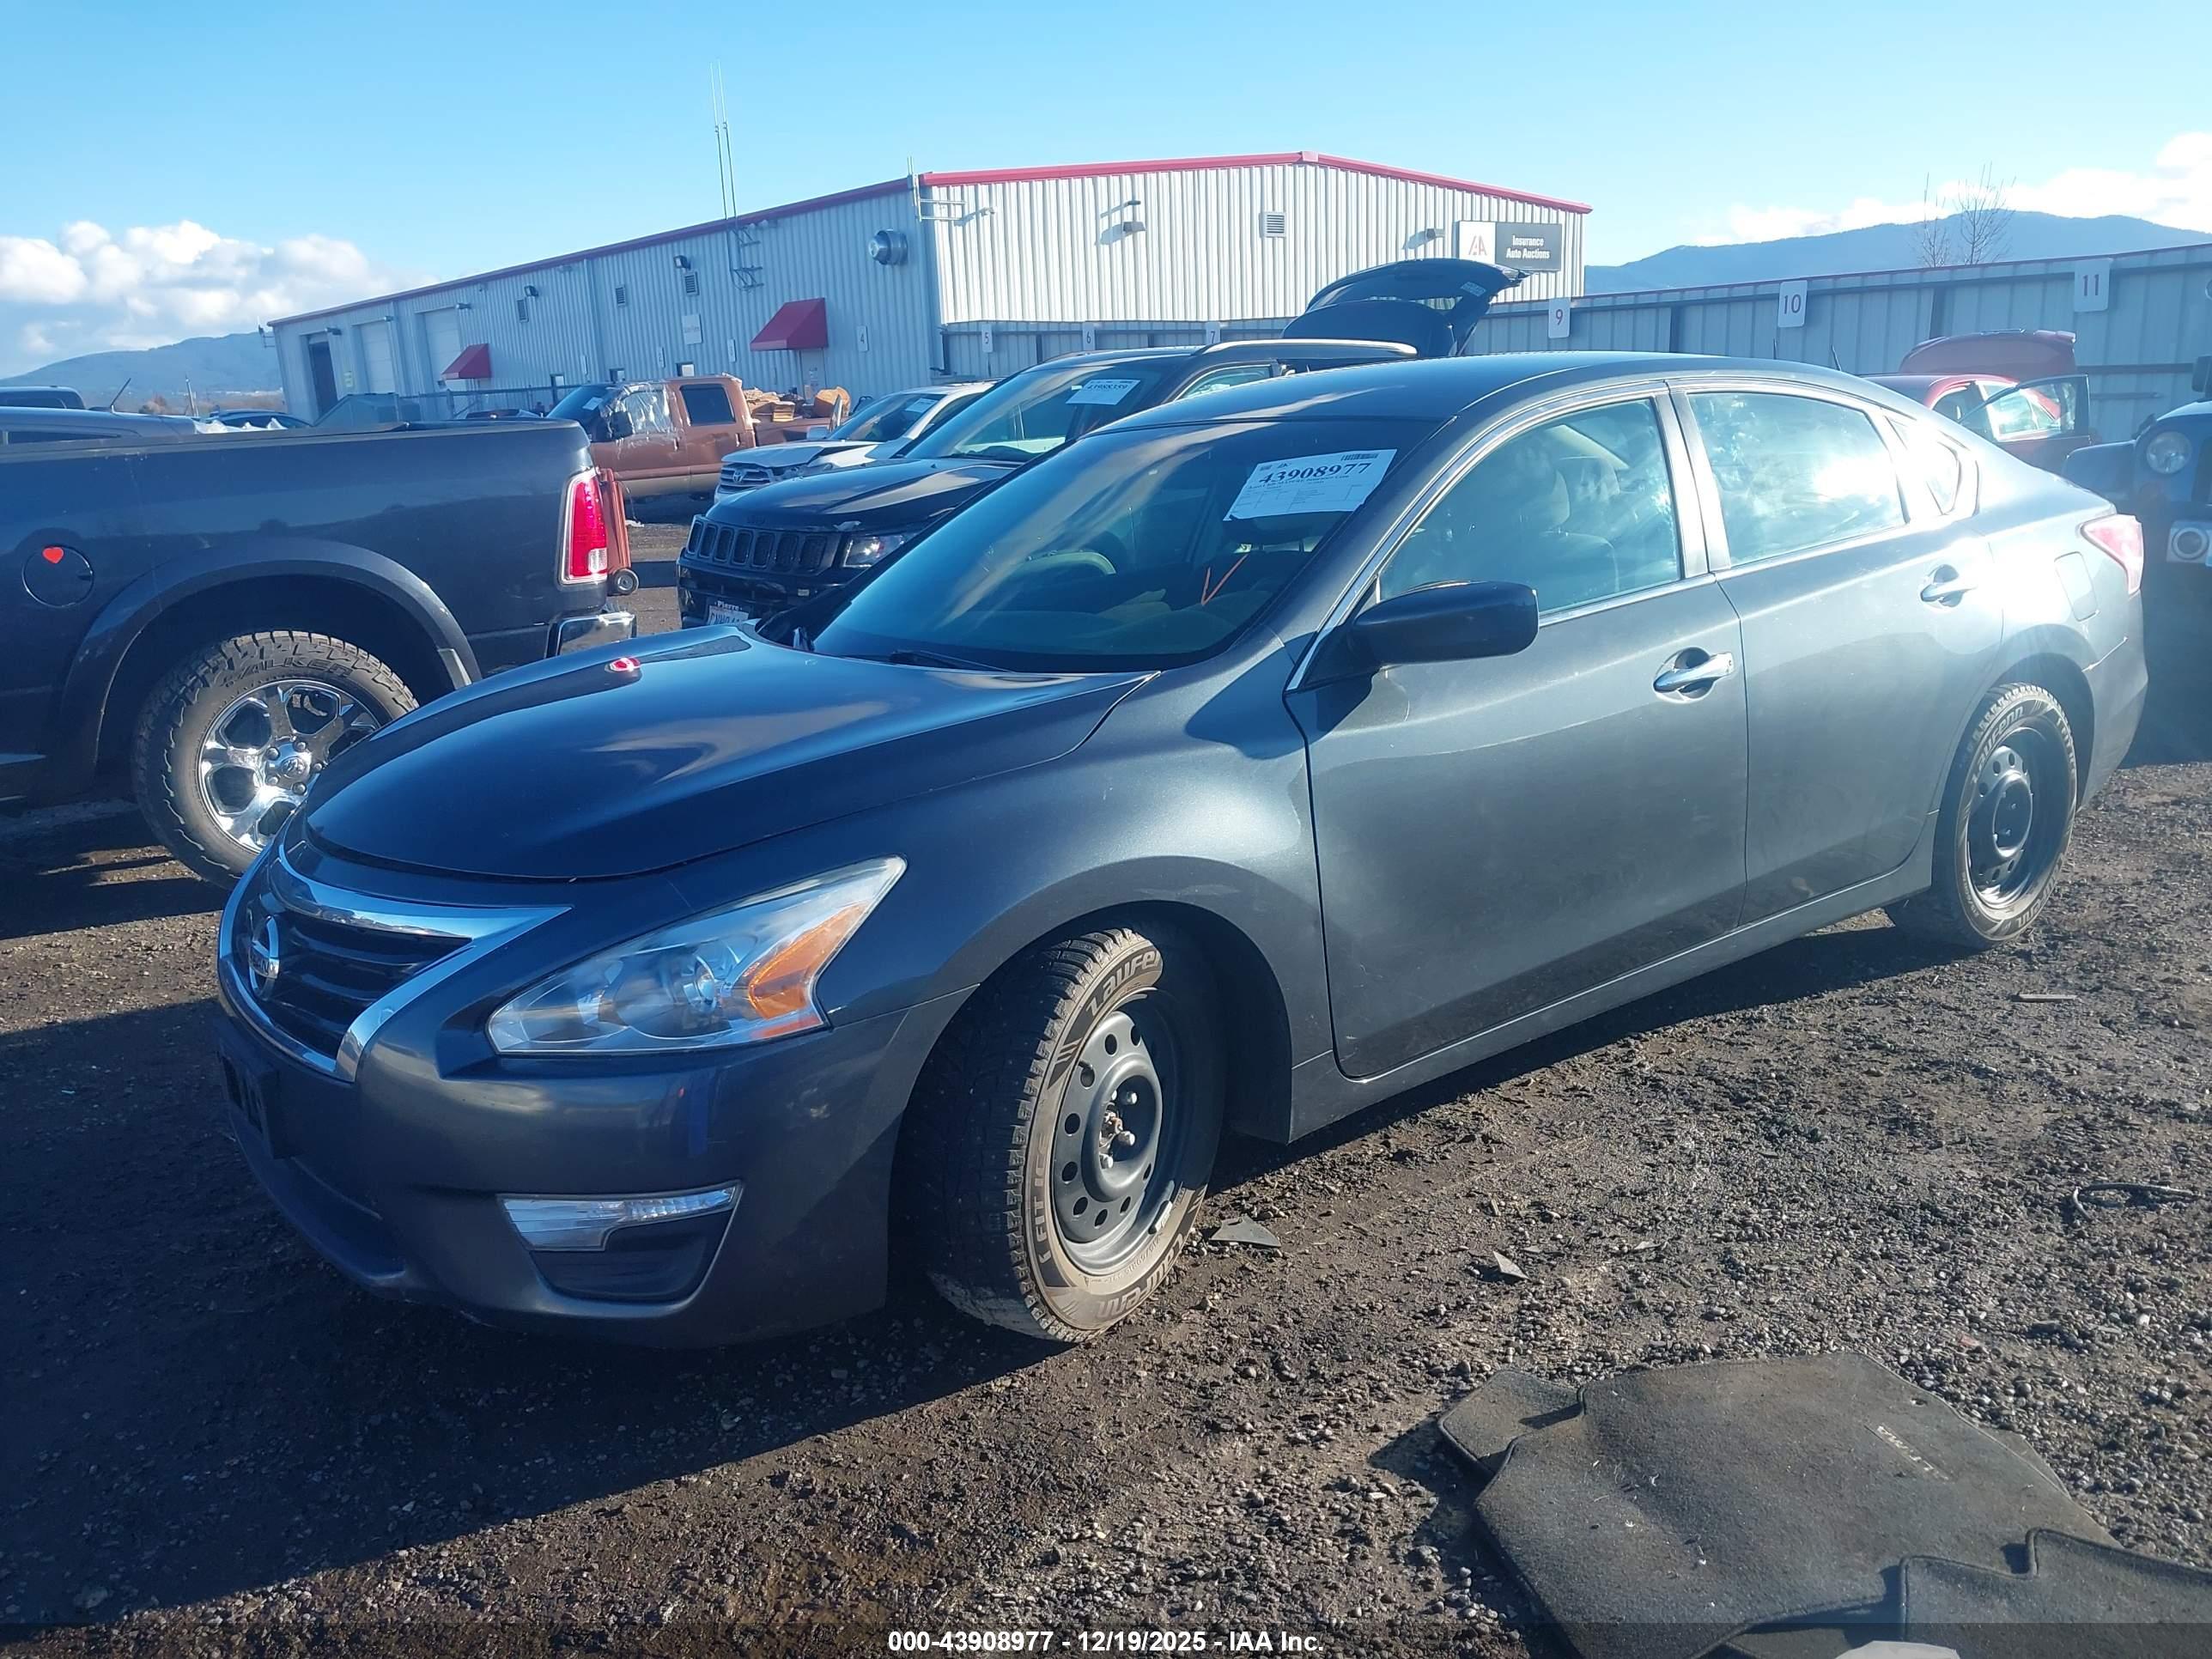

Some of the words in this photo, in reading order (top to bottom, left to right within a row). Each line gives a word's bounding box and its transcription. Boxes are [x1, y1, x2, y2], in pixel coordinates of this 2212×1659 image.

[1512, 234, 1544, 246] Insurance
[1506, 247, 1522, 259] Auto
[1522, 247, 1550, 259] Auctions
[2081, 273, 2101, 297] 11
[1783, 294, 1802, 314] 10
[1555, 308, 1564, 326] 9
[860, 333, 865, 344] 4
[984, 331, 989, 344] 5
[1086, 331, 1091, 344] 6
[1209, 331, 1216, 343] 7
[1259, 462, 1372, 483] 43908977
[1033, 1196, 1047, 1243] FIT
